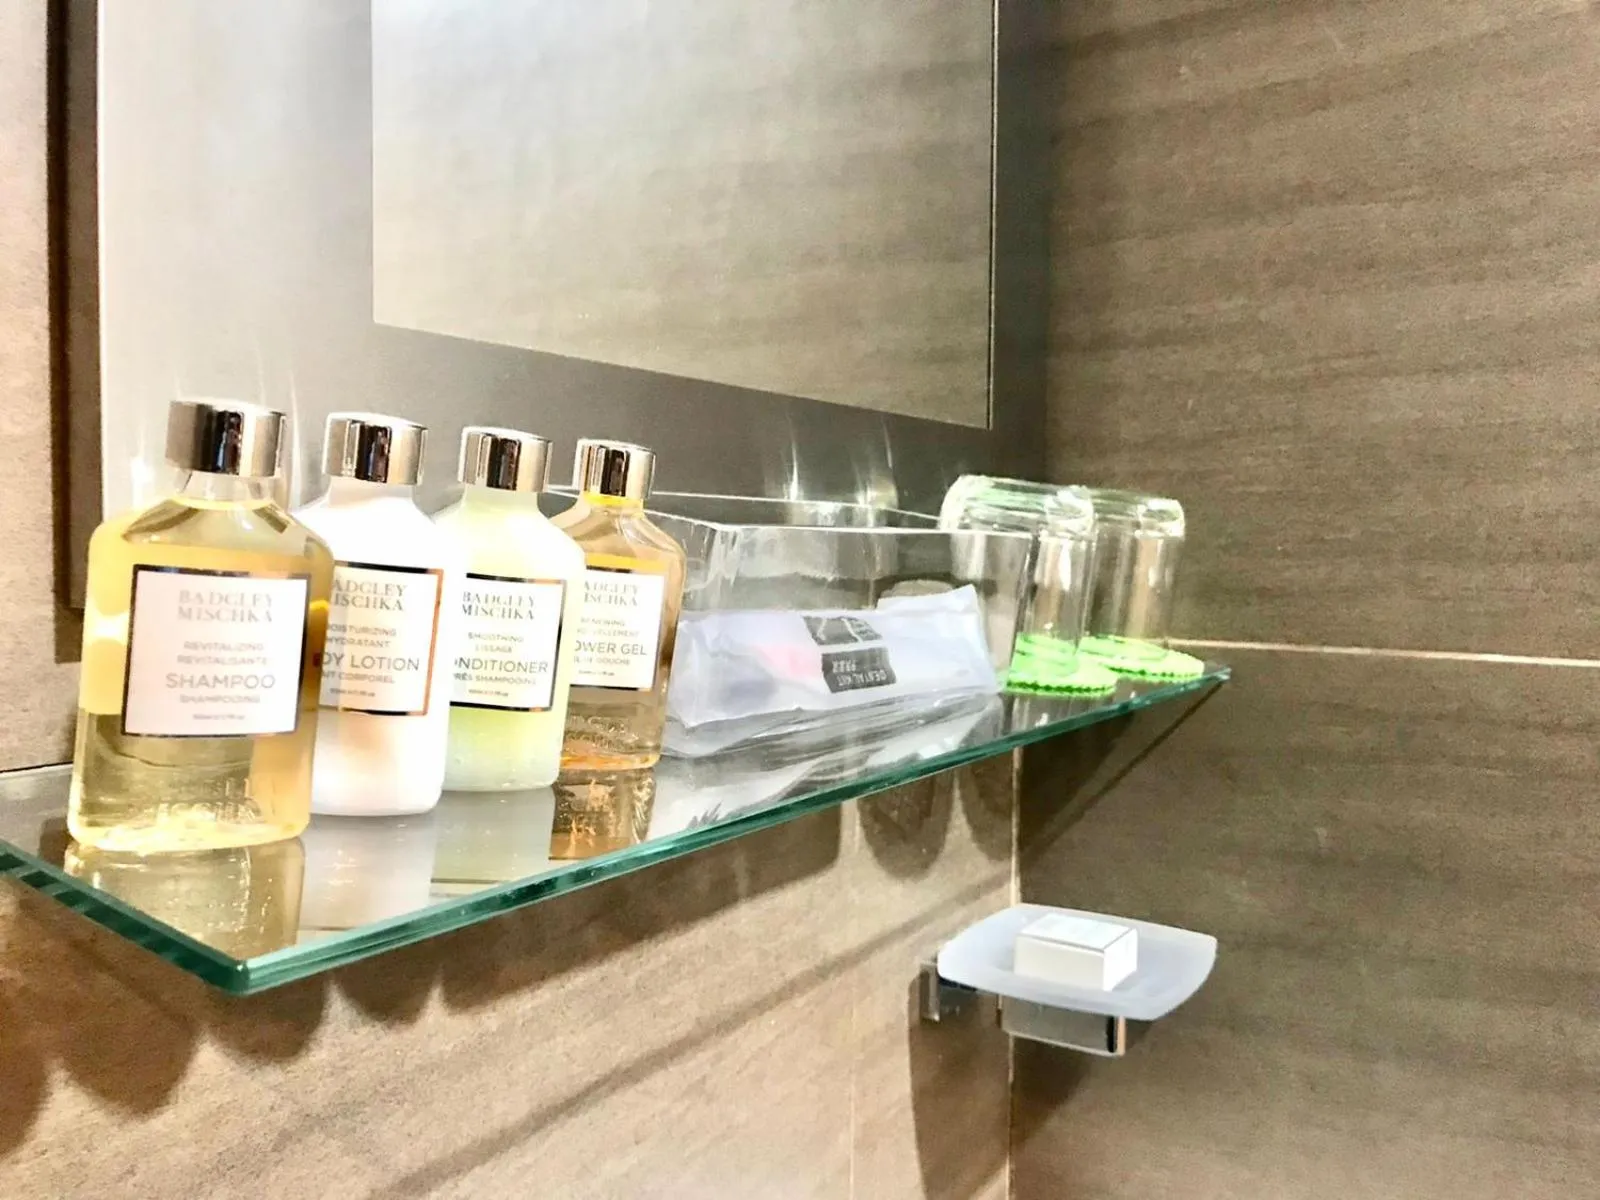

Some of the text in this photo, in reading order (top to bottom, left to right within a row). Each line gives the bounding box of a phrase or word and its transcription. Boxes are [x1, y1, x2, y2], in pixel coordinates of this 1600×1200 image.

[333, 579, 407, 597] ADGLEY
[583, 580, 640, 596] ADGLEY
[179, 589, 273, 608] BADGLEY
[334, 592, 404, 611] ISCHKA
[583, 591, 638, 607] ISCHKA
[177, 606, 273, 623] MISCHKA
[462, 604, 534, 620] MISCHKA
[328, 623, 396, 637] OISTURIZING
[620, 643, 648, 656] GEL
[322, 652, 420, 672] DY LOTION
[454, 657, 549, 674] NDITIONER
[165, 672, 276, 690] SHAMPOO
